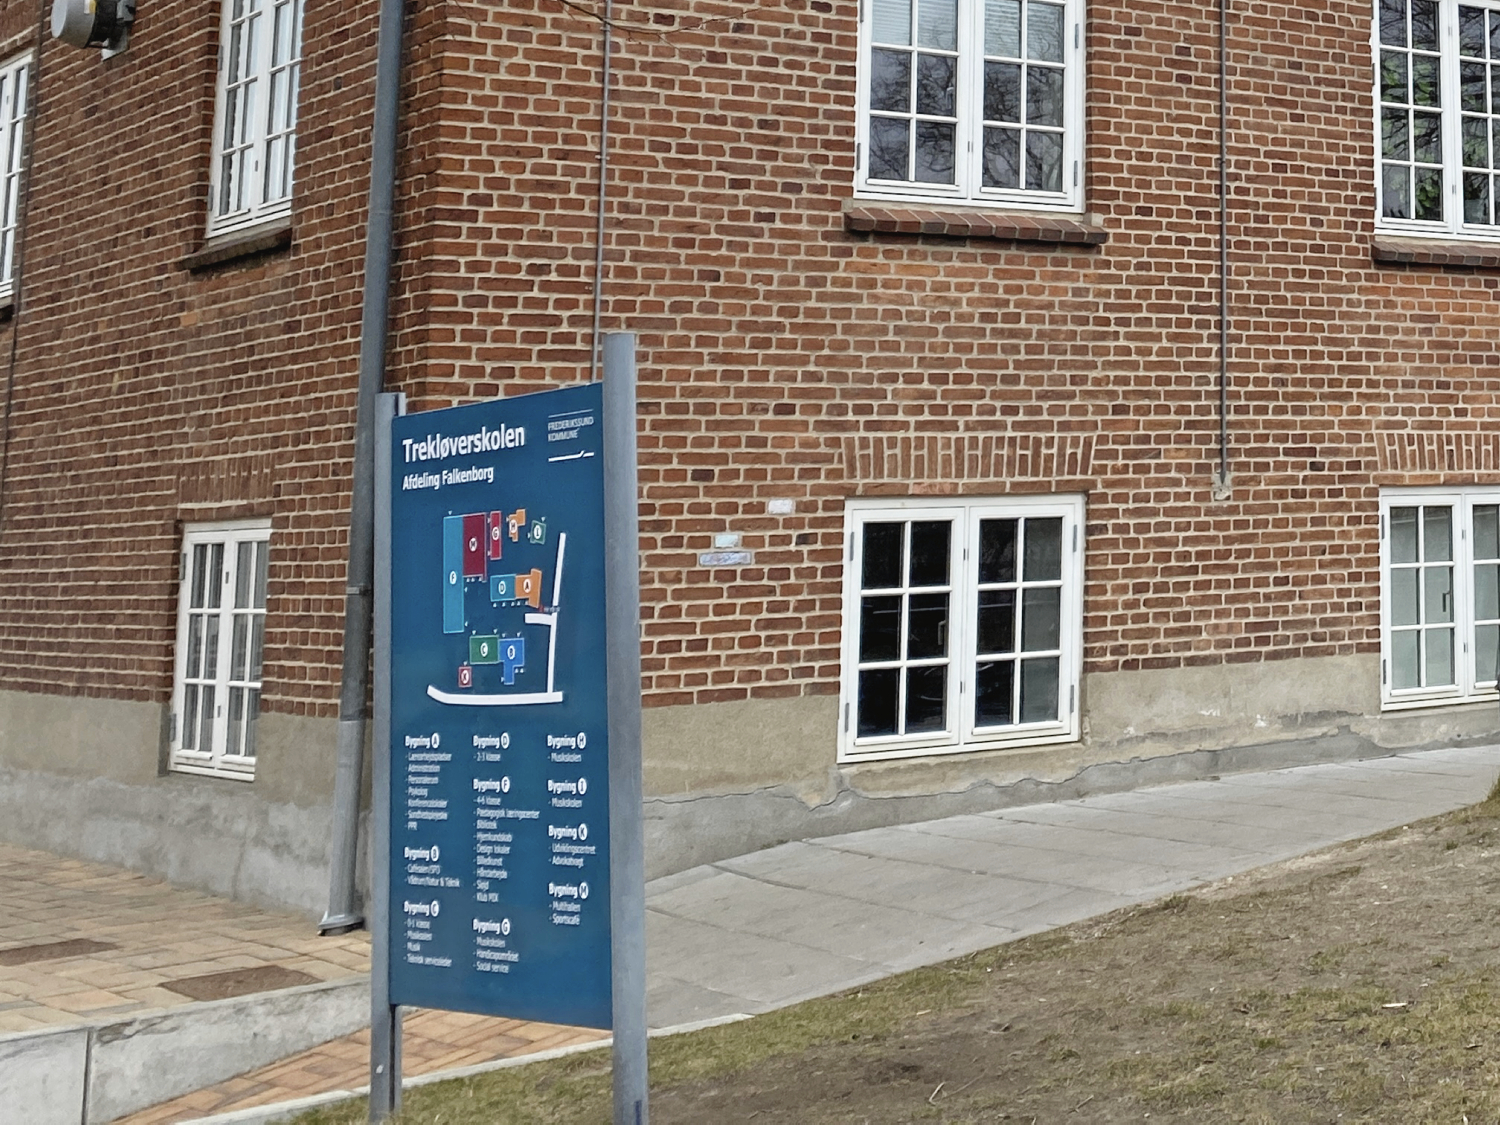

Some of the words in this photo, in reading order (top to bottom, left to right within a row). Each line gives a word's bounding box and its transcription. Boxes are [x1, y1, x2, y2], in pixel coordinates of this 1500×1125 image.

[547, 416, 595, 431] FREDERIKSSUND
[402, 423, 525, 463] Trekløverskolen
[547, 429, 579, 442] KOMMUNE
[402, 472, 440, 491] Afdeling
[442, 466, 494, 485] Falkenborg
[405, 735, 430, 749] Bygning
[473, 735, 500, 749] Bygning
[547, 735, 576, 749] Bygning
[473, 778, 500, 793] Bygning
[547, 779, 577, 794] Bygning
[548, 824, 577, 840] Bygning
[404, 846, 430, 861] Bygning
[548, 882, 578, 899] Bygning
[404, 900, 430, 916] Bygning
[473, 918, 500, 934] Bygning
